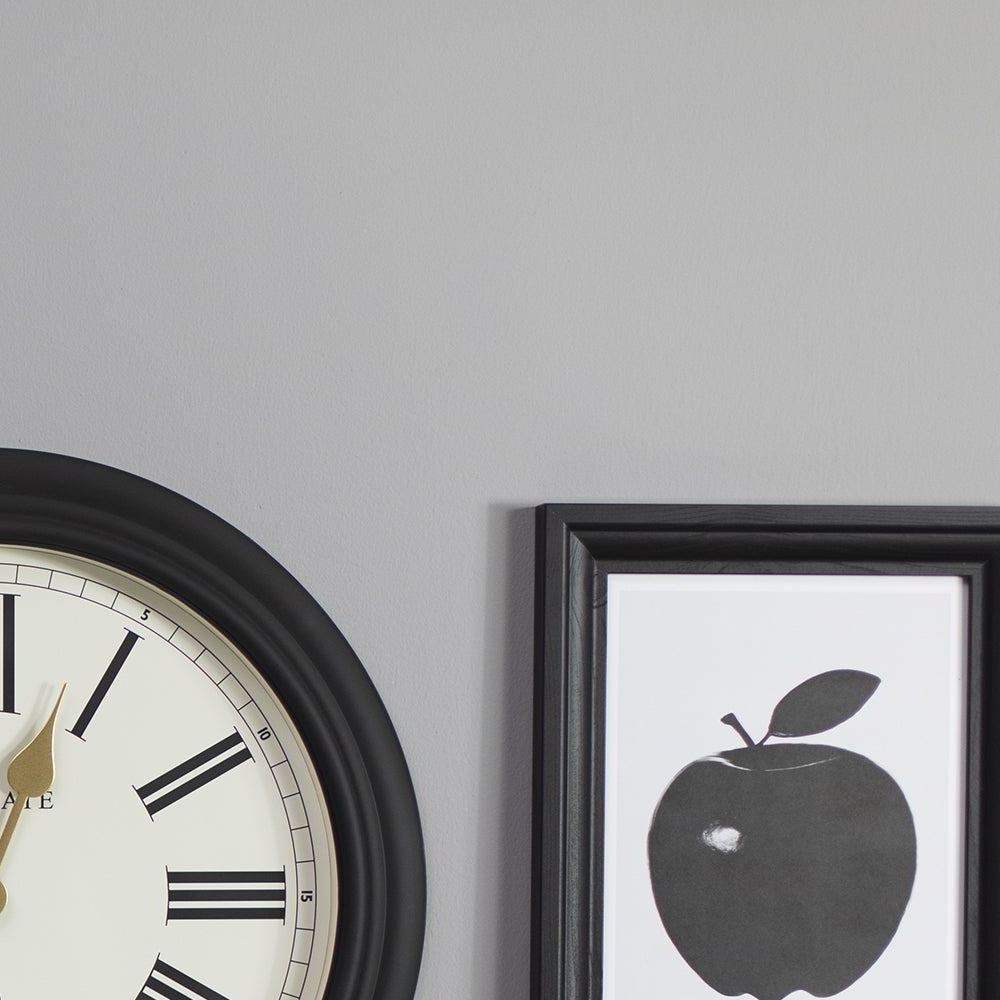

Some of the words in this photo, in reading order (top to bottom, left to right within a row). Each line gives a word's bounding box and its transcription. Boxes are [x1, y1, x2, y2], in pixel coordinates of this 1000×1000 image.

[140, 609, 151, 621] 5
[65, 627, 145, 742] I
[256, 727, 271, 741] 10
[132, 726, 256, 822] II
[165, 865, 286, 926] III
[300, 890, 312, 903] 15
